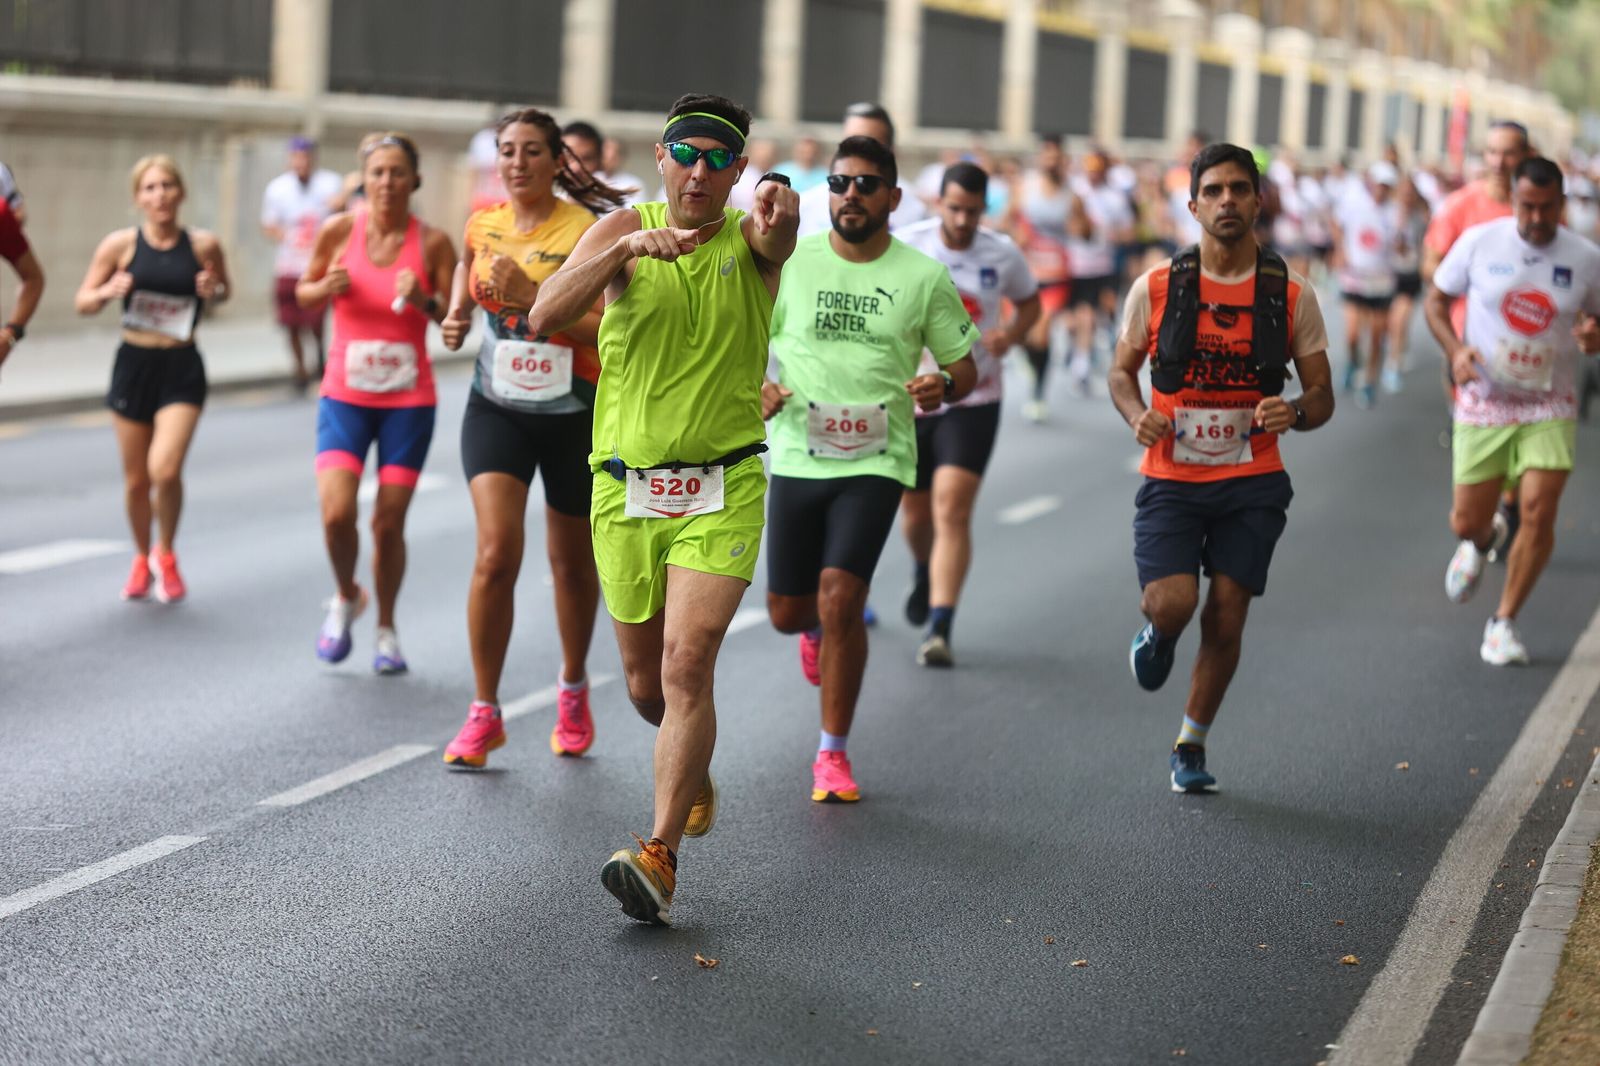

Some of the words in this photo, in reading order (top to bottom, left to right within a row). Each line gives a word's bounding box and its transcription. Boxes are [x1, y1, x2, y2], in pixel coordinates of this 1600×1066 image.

[816, 291, 883, 315] FOREVER.
[815, 312, 870, 334] FASTER.
[512, 357, 552, 373] 606
[824, 418, 869, 433] 206
[1195, 424, 1236, 439] 169
[649, 477, 701, 496] 520
